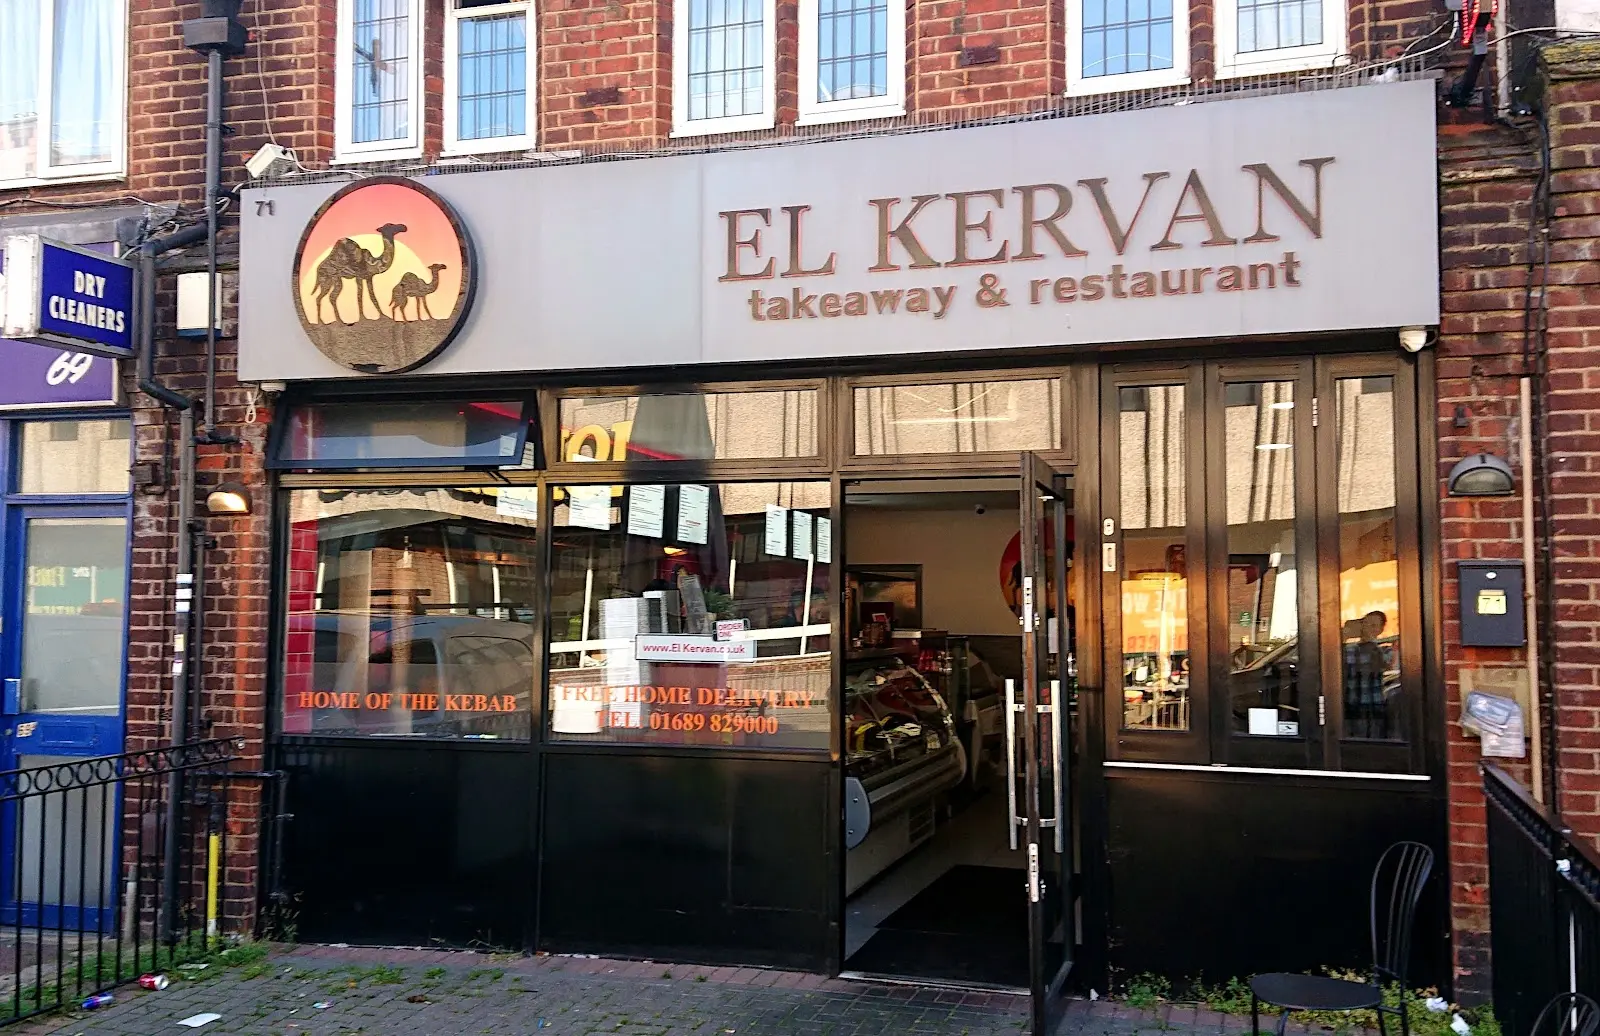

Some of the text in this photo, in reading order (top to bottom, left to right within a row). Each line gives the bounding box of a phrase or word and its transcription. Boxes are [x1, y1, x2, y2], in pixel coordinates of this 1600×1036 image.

[254, 199, 275, 217] 71
[719, 156, 1336, 282] EL KERVAN
[73, 270, 106, 299] DRY
[748, 250, 1302, 321] takeaway & restaurant
[49, 295, 125, 333] CLEANERS
[46, 350, 94, 386] 69
[718, 621, 743, 631] ORDER
[300, 691, 518, 713] HOME OF THE KEBAB
[562, 685, 816, 710] FREE HOME DELIVERY
[650, 712, 704, 731] 01689
[710, 712, 779, 735] 829000
